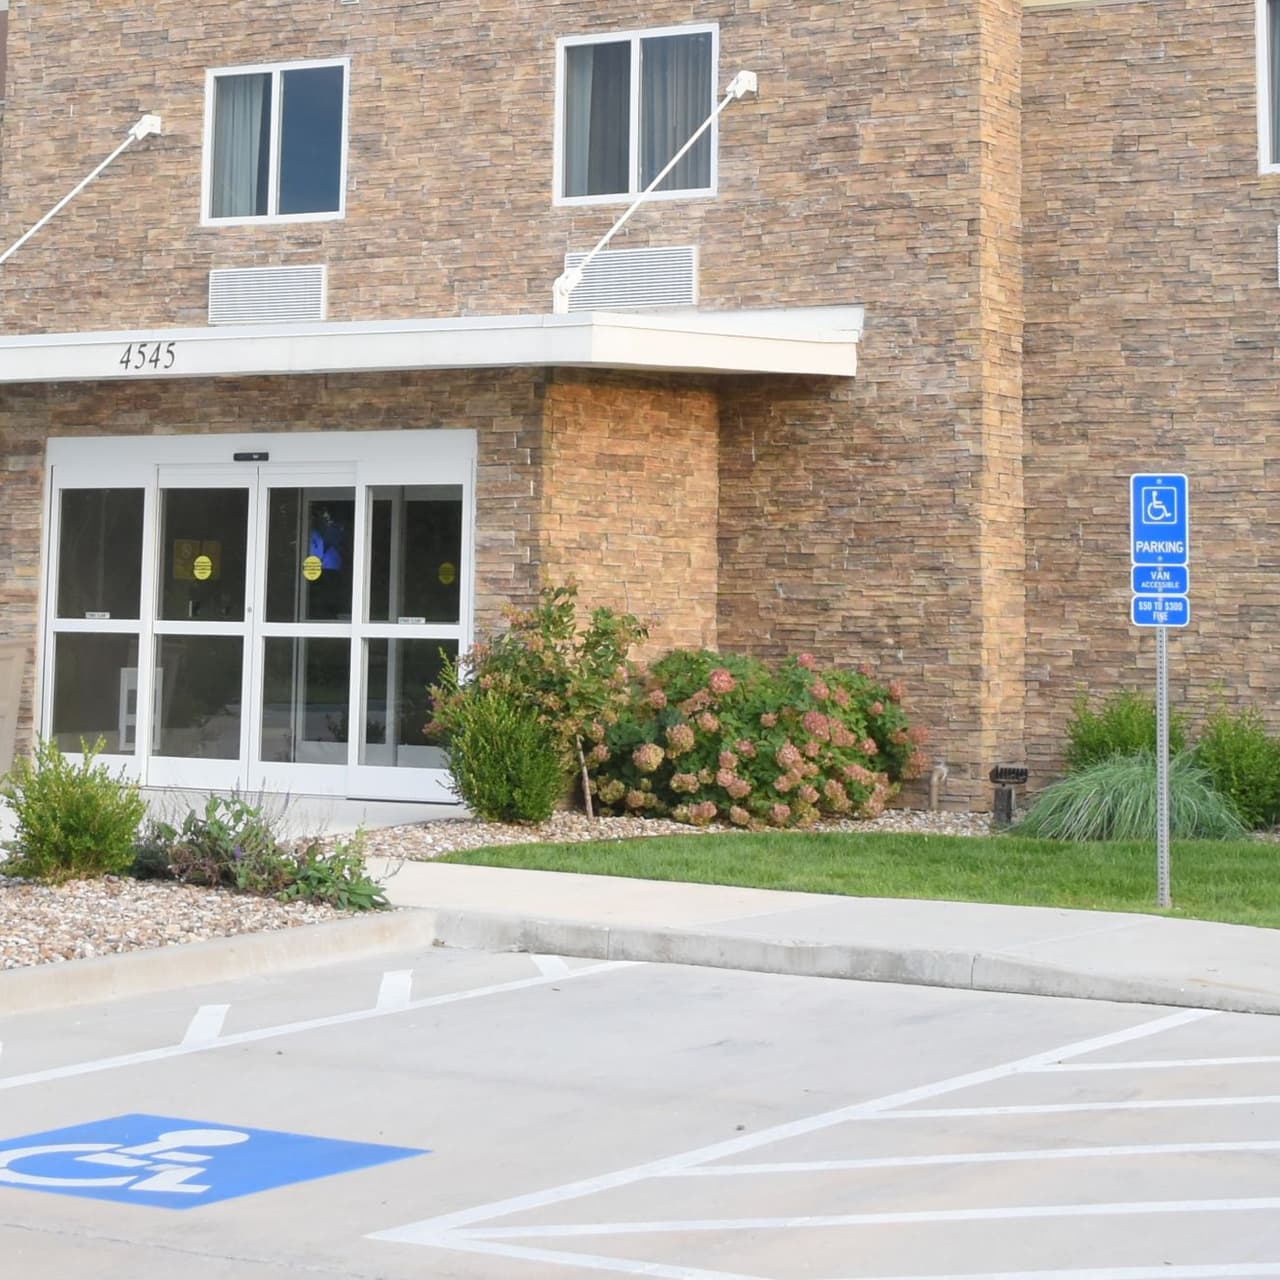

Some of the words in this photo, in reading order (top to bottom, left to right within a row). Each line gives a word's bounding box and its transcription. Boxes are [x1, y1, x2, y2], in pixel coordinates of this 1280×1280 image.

[120, 341, 176, 370] 4545
[1136, 541, 1184, 553] PARKING
[1150, 570, 1170, 580] VAN
